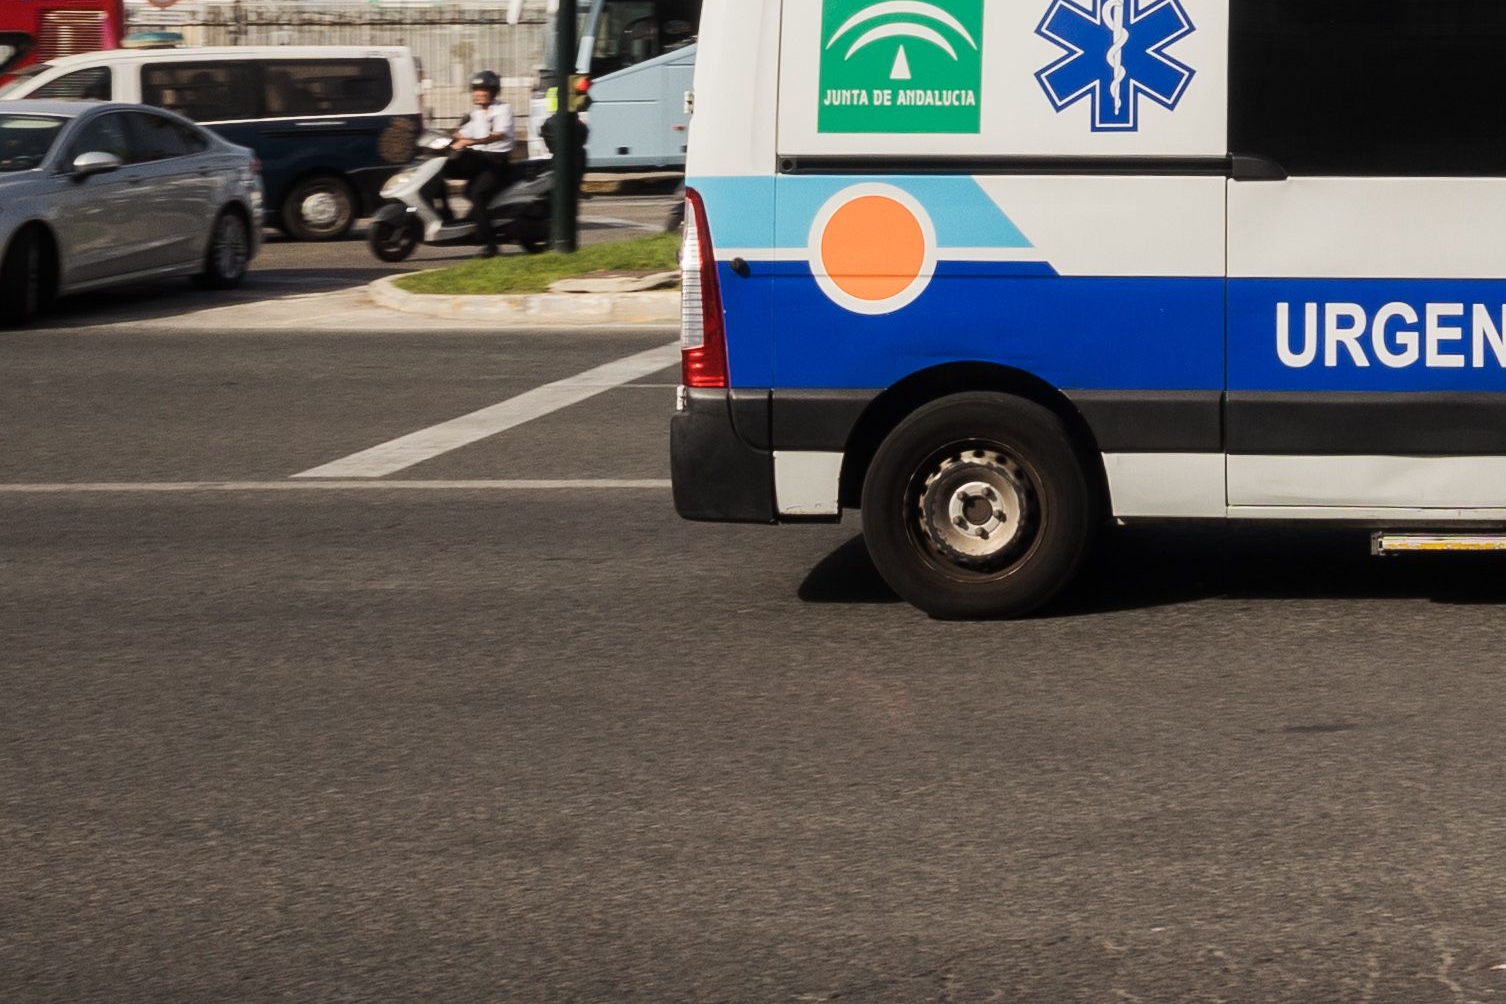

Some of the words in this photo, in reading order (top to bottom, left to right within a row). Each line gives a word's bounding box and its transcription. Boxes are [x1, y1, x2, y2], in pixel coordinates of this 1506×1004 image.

[823, 89, 869, 106] JUNTA
[872, 89, 893, 106] DE
[896, 89, 976, 107] ANDALUCIA
